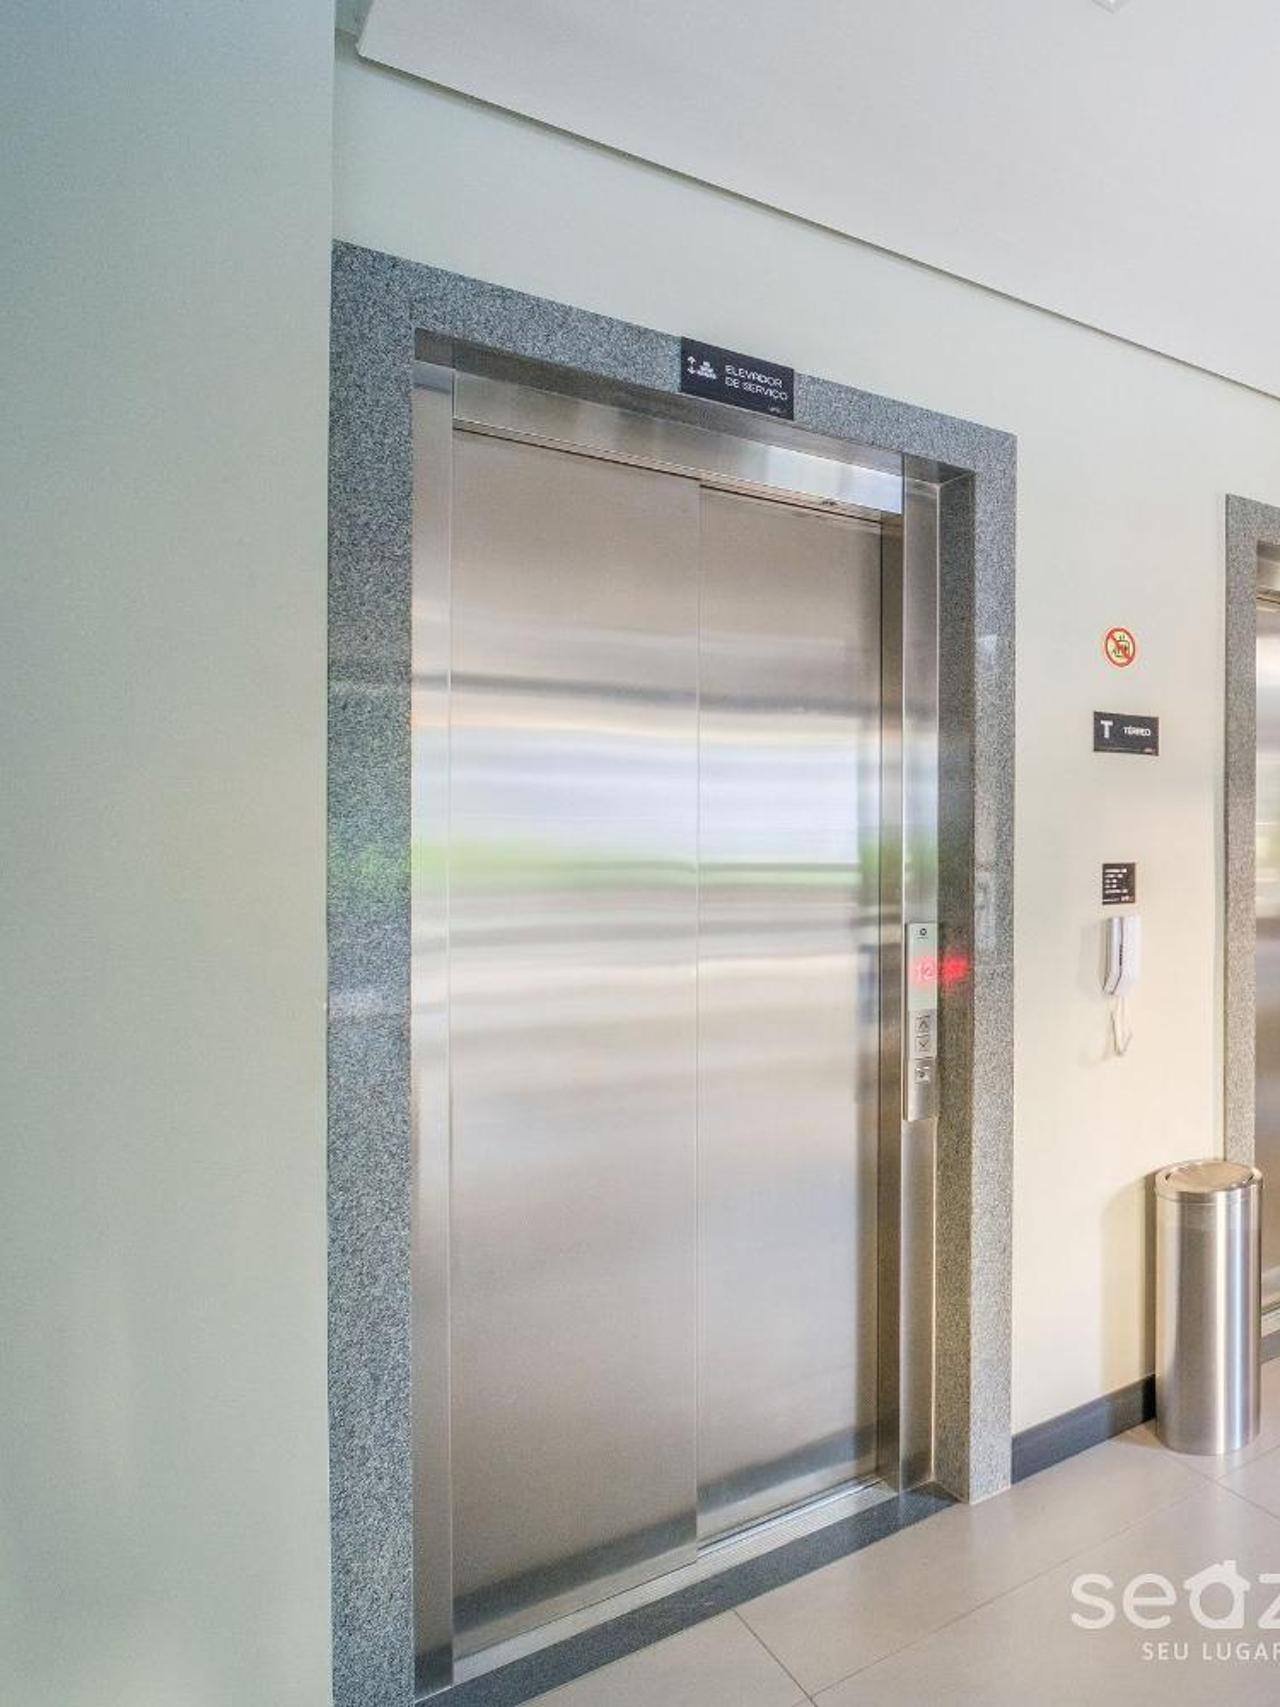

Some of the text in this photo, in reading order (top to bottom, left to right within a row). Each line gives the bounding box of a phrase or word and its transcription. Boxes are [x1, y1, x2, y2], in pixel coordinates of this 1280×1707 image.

[725, 364, 782, 388] ELEVADOR
[725, 376, 740, 389] DE
[1100, 719, 1114, 739] T
